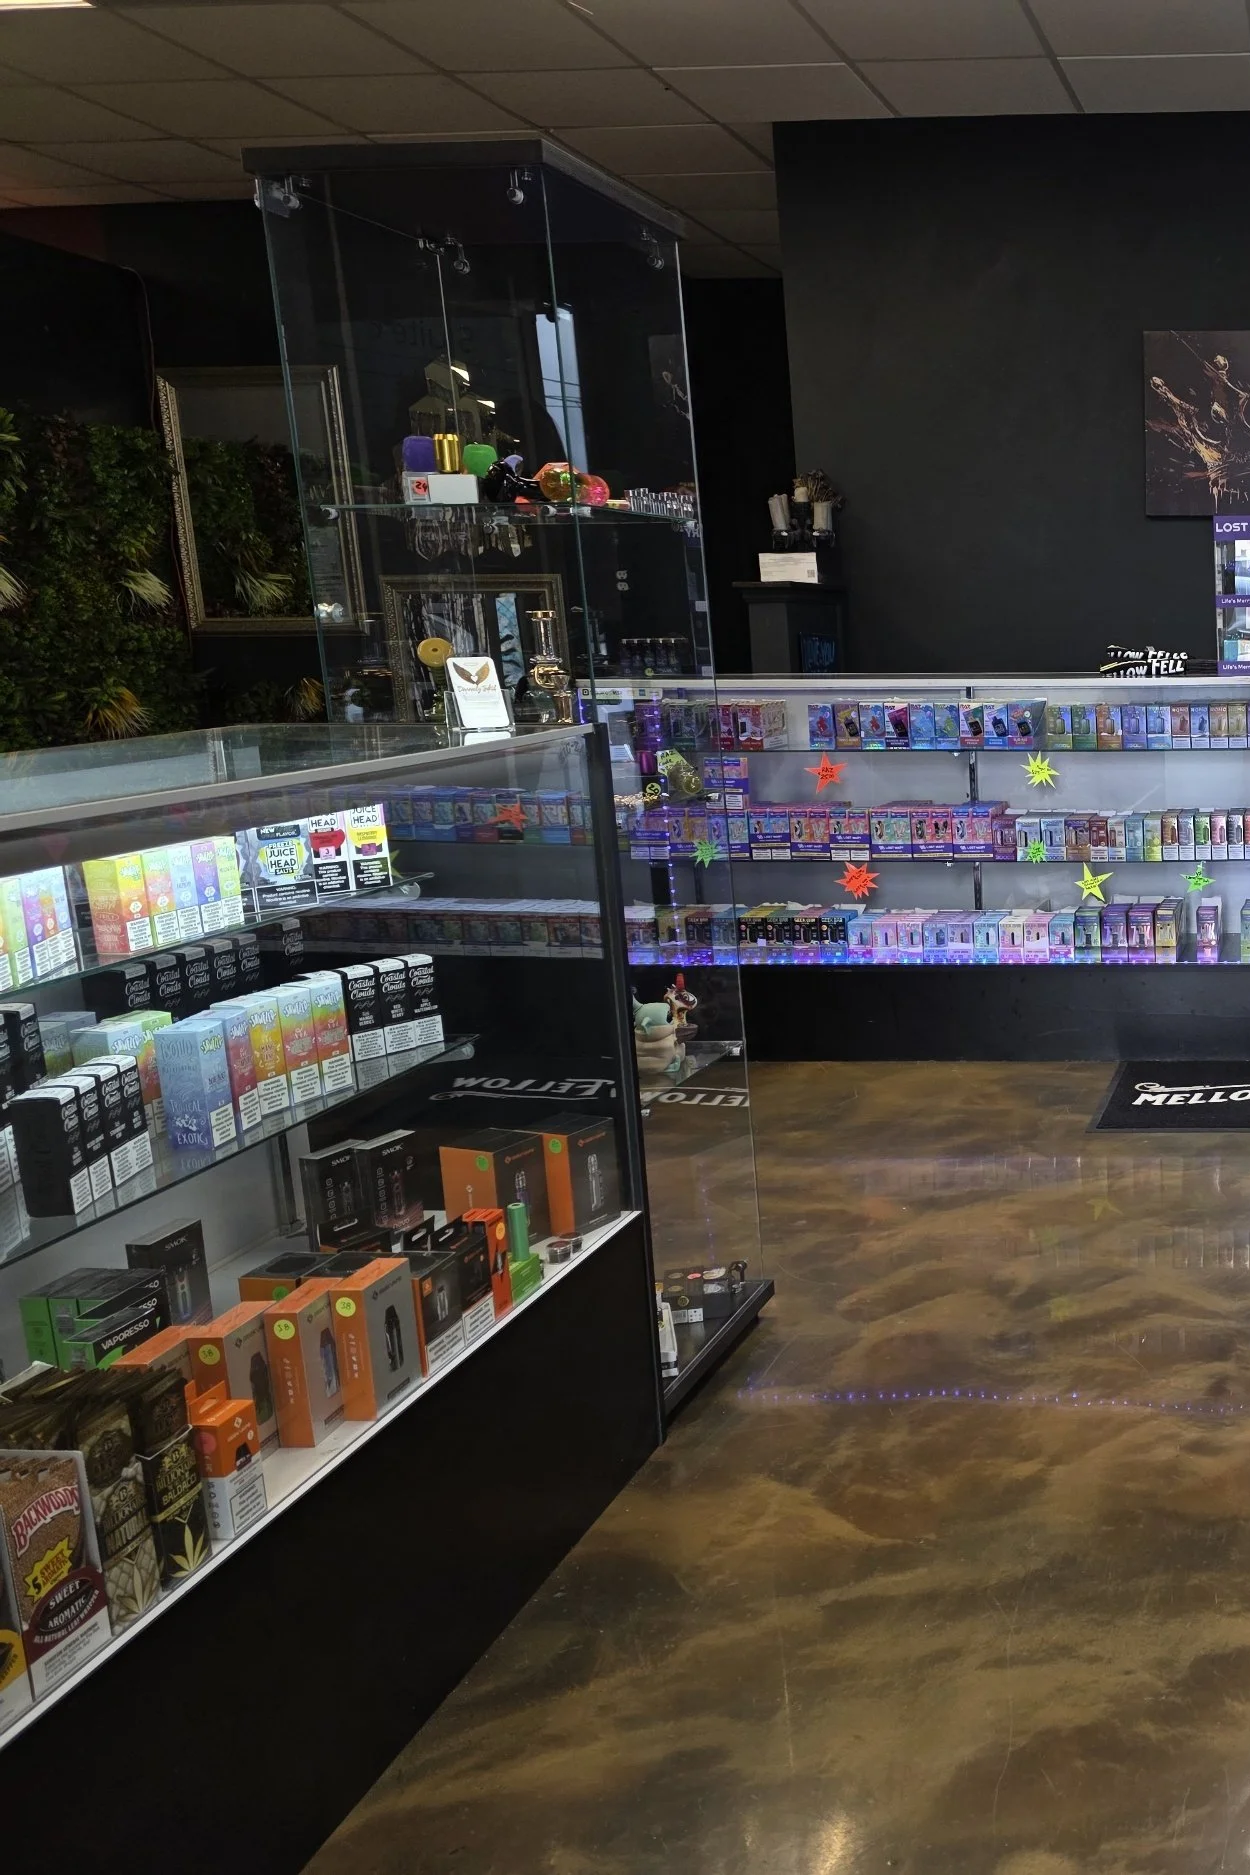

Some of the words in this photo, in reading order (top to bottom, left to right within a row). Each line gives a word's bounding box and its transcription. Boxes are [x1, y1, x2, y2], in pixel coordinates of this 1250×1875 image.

[1216, 522, 1249, 533] LOST
[352, 806, 376, 814] JUICE
[311, 818, 336, 828] HEAD
[353, 815, 378, 824] HEAD
[268, 840, 293, 849] FREEZE
[269, 848, 295, 858] JUICE
[270, 859, 296, 869] HEAD
[275, 867, 293, 875] SALTS
[282, 930, 303, 945] Coastal
[239, 945, 260, 960] Coastal
[285, 942, 304, 955] Clouds
[214, 951, 236, 968] Coastal
[241, 958, 260, 971] Clouds
[186, 959, 209, 977] Coastal
[216, 966, 236, 980] Clouds
[409, 965, 434, 978] Coastal
[156, 968, 180, 985] Coastal
[189, 975, 210, 988] Clouds
[380, 971, 405, 984] Coastal
[411, 975, 434, 987] Clouds
[125, 977, 150, 995] Coastal
[159, 983, 181, 997] Clouds
[348, 978, 375, 992] Coastal
[382, 981, 406, 993] Clouds
[128, 993, 151, 1007] Clouds
[350, 987, 375, 1000] Clouds
[177, 1131, 208, 1145] EXOTIC
[381, 1145, 404, 1157] SMOK
[164, 1235, 188, 1251] SMOK
[339, 1301, 351, 1311] 38
[101, 1318, 150, 1351] VAPORESSO
[12, 1485, 80, 1554] BACKWOODS
[32, 1577, 41, 1595] 5
[49, 1580, 80, 1610] SWEET
[44, 1626, 67, 1643] NATURAL
[67, 1616, 81, 1634] LEAF
[78, 1589, 100, 1622] WRAPPER
[48, 1594, 86, 1628] AROMATIC
